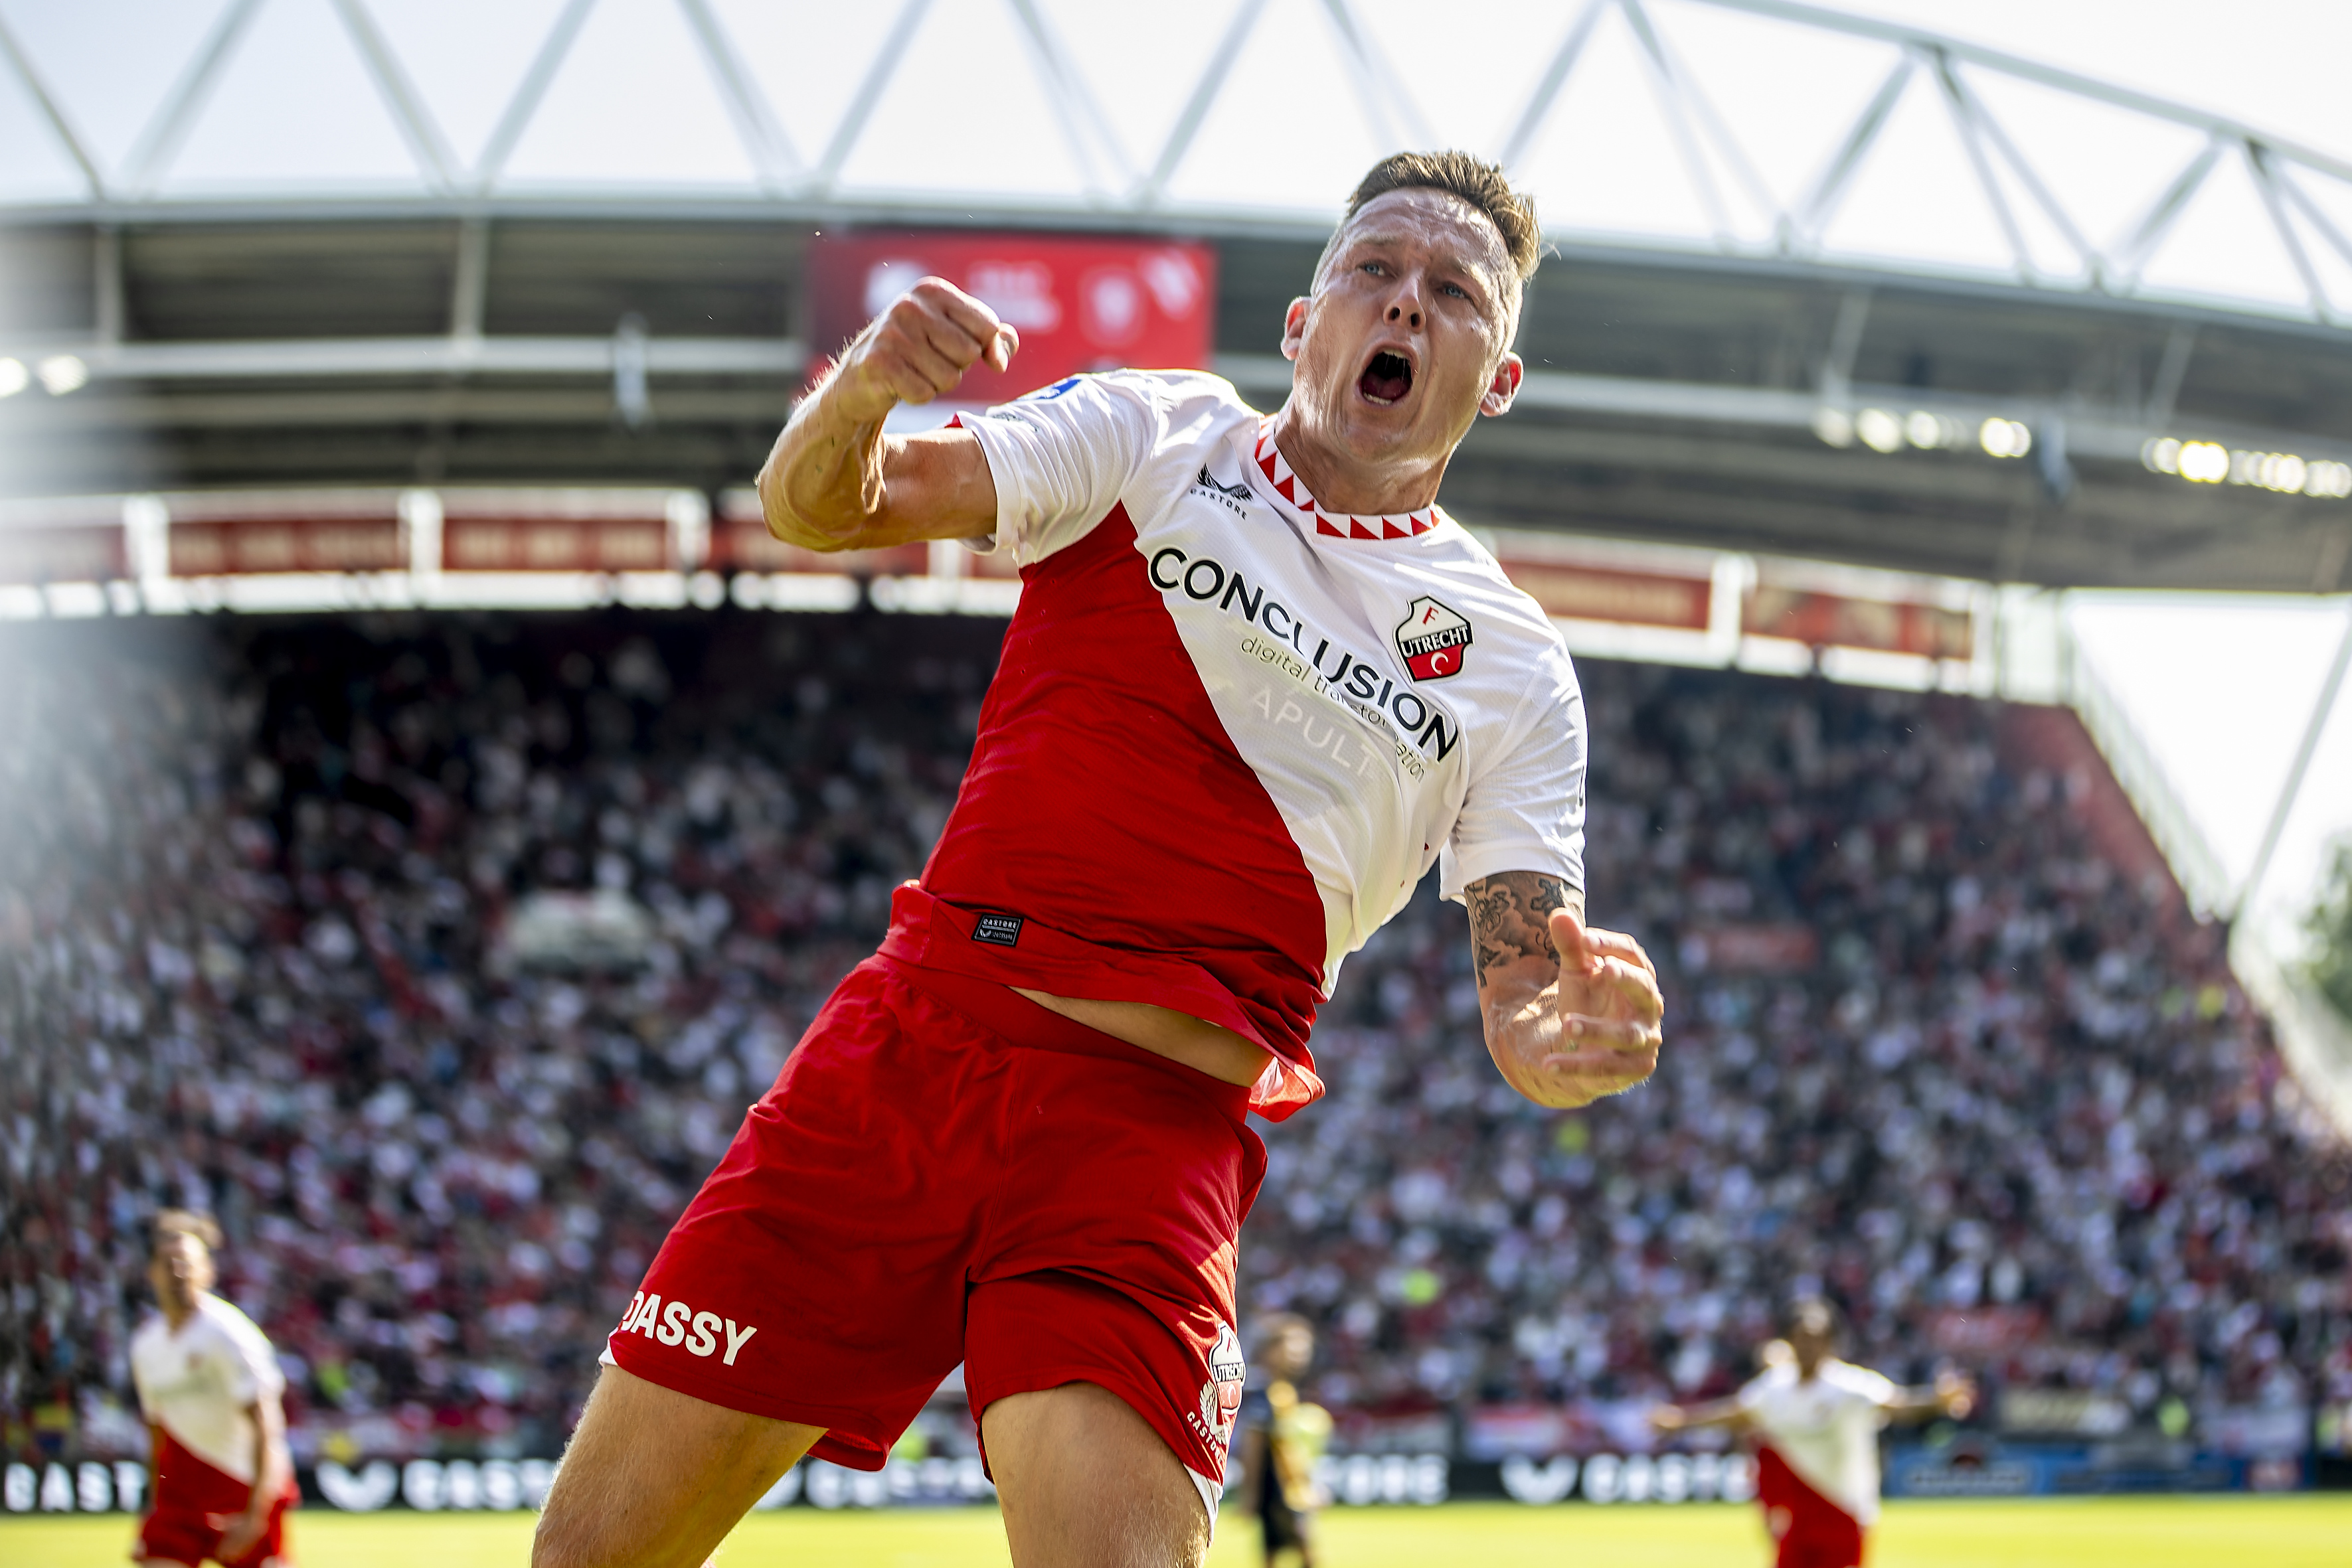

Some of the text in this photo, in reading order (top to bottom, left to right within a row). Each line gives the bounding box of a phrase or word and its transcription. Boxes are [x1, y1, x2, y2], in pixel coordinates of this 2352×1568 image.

[1190, 488, 1247, 520] CASTORE
[1422, 605, 1439, 625] F
[1150, 548, 1458, 761] CONCLUSION
[1241, 637, 1311, 682] digital
[1400, 625, 1468, 658] UTRECHT
[983, 918, 1017, 929] CASTORE
[621, 1290, 758, 1367] DASSY
[1213, 1362, 1244, 1383] UTRECHT
[1187, 1411, 1224, 1464] CASTOR
[3, 1460, 150, 1513] CAST
